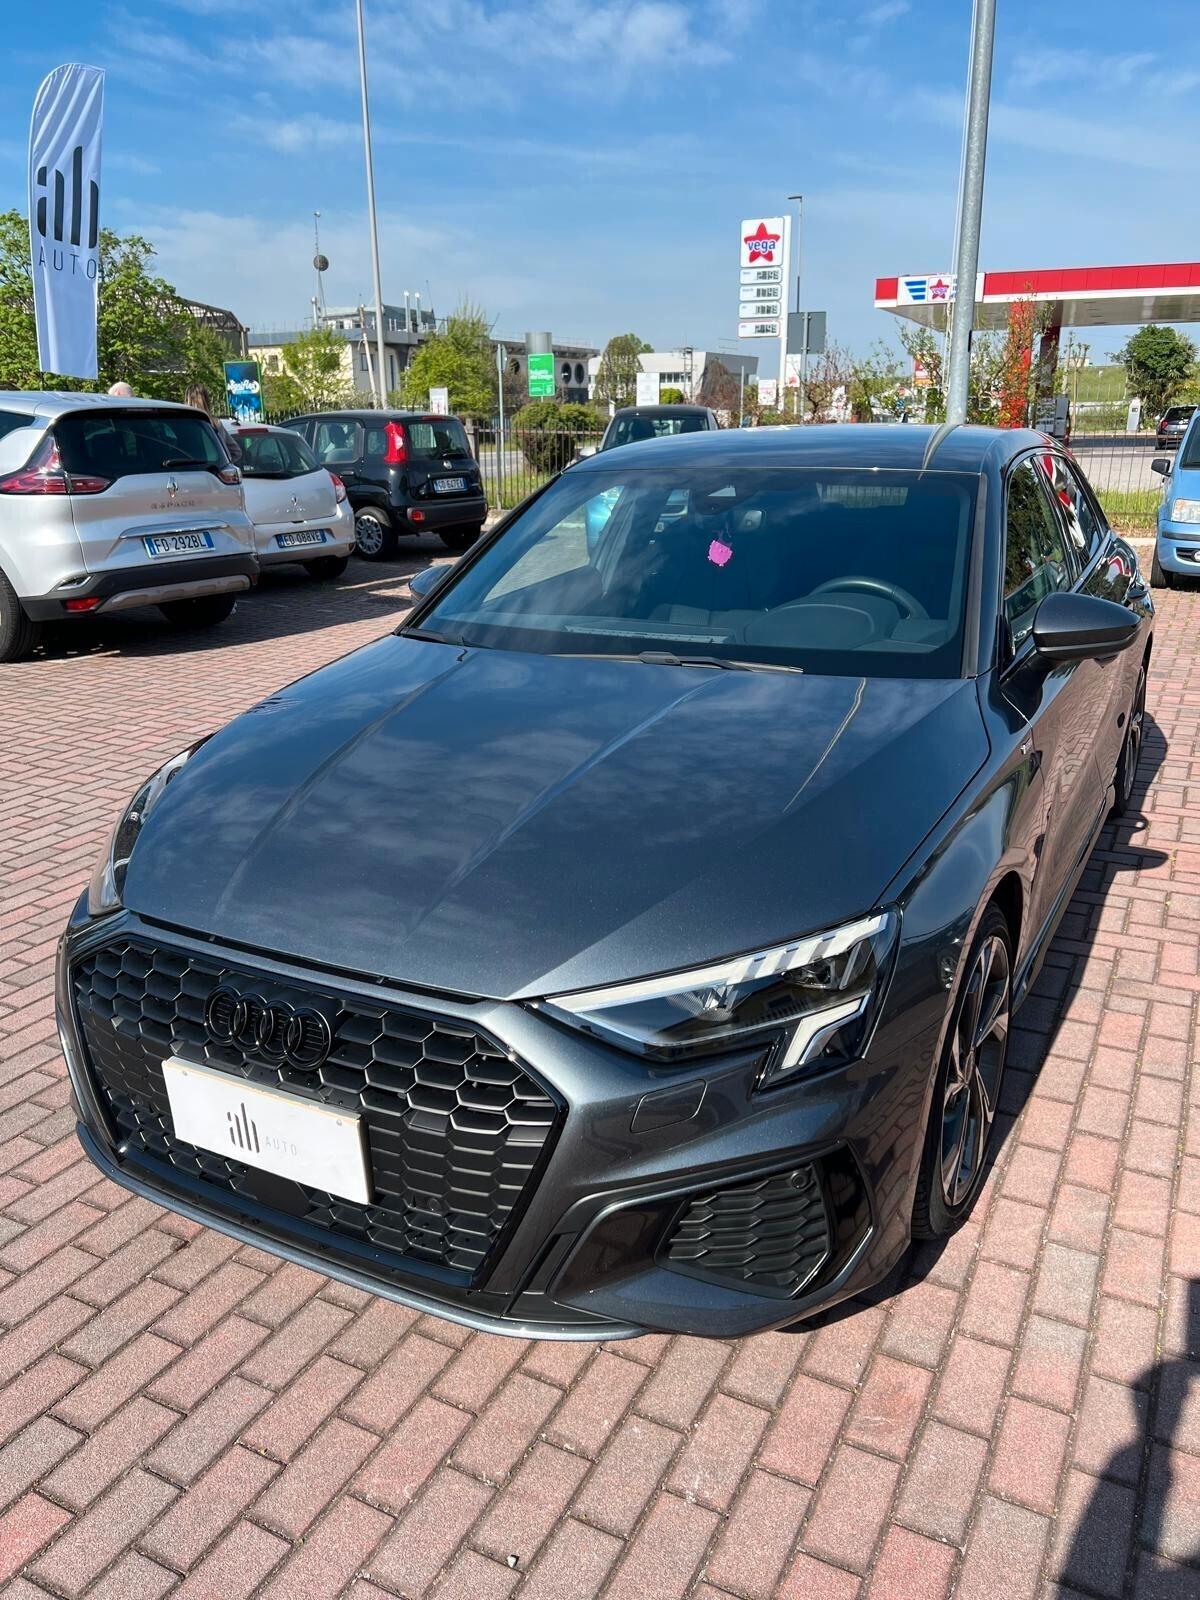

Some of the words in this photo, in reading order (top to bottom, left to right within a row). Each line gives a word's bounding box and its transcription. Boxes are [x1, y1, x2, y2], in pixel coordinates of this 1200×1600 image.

[748, 239, 776, 253] vega
[38, 247, 97, 279] AUTO
[172, 534, 206, 551] 292BL
[265, 1136, 297, 1156] AUTO
